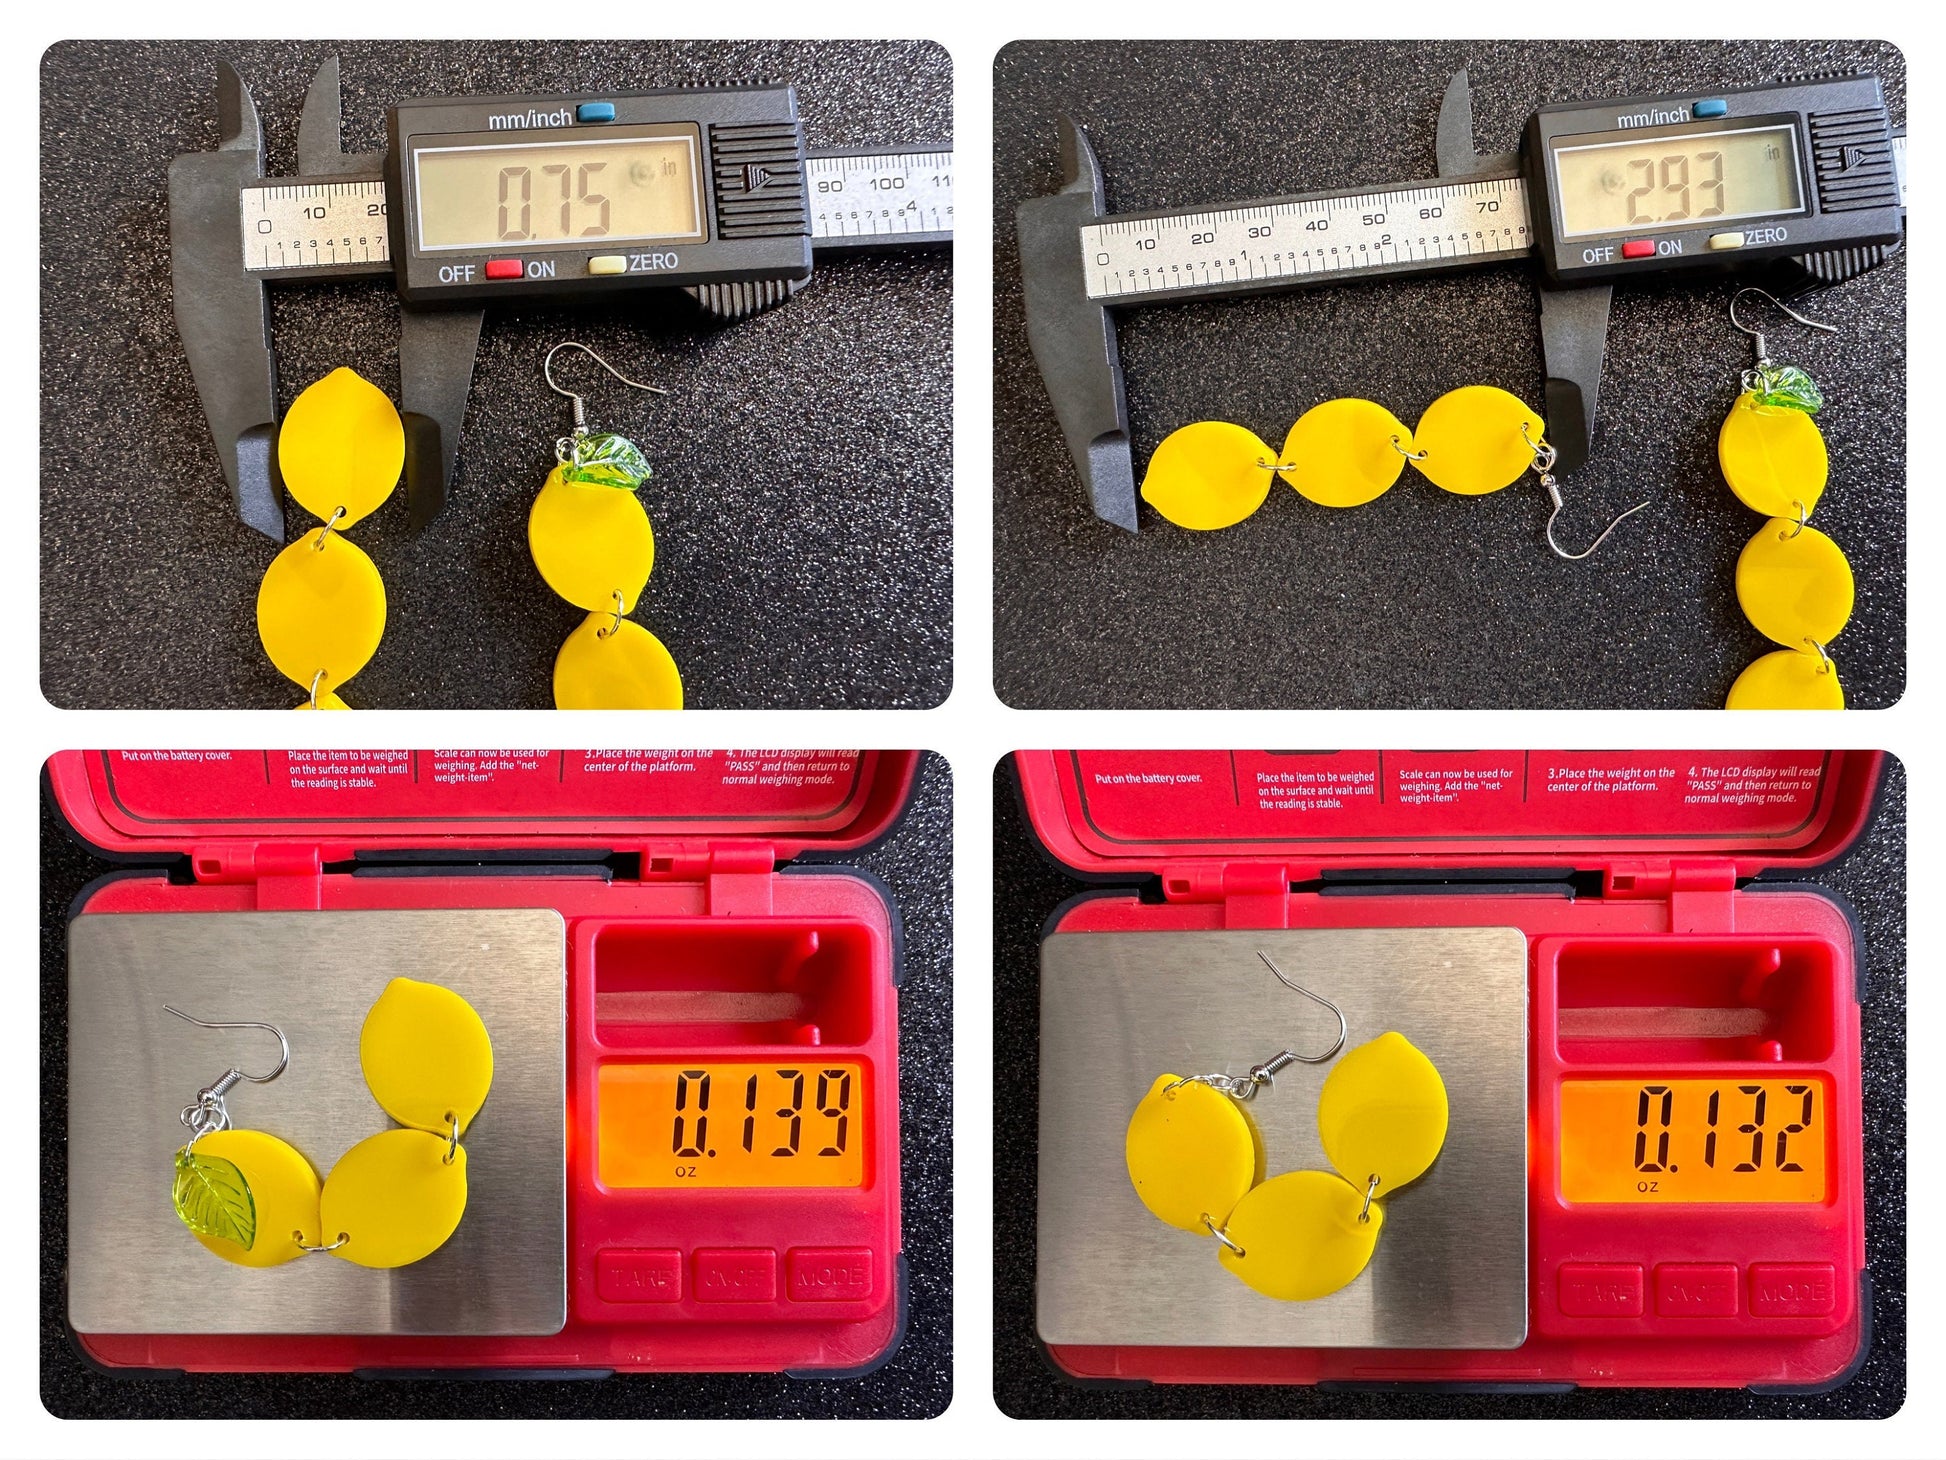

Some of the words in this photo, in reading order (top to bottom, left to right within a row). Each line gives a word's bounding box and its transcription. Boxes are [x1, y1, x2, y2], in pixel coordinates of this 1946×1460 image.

[488, 108, 573, 130] mm/inch
[1617, 106, 1690, 129] mm/inch
[1766, 144, 1780, 161] in
[662, 157, 677, 178] in
[817, 180, 843, 193] 90
[869, 177, 904, 191] 100
[932, 174, 953, 187] 11
[1626, 151, 1725, 225] 2.93
[498, 162, 611, 241] 0.75
[906, 200, 917, 212] 4
[303, 206, 326, 219] 10
[257, 219, 272, 234] 0
[1136, 238, 1156, 251] 10
[1191, 232, 1215, 245] 20
[1248, 226, 1272, 239] 30
[1305, 219, 1329, 232] 40
[1362, 213, 1386, 226] 50
[1419, 207, 1442, 220] 60
[1476, 201, 1499, 214] 70
[1381, 234, 1392, 246] 2
[1745, 227, 1788, 246] ZERO
[1240, 250, 1248, 261] 1
[1582, 247, 1614, 264] OFF
[1658, 240, 1683, 256] ON
[629, 252, 678, 272] ZERO
[1096, 252, 1110, 266] 0
[438, 264, 476, 283] OFF
[527, 260, 556, 279] ON
[121, 750, 139, 761] Put
[140, 752, 152, 760] on
[153, 750, 169, 760] the
[170, 750, 204, 762] battery
[205, 751, 233, 760] cover.
[287, 750, 311, 761] Place
[312, 750, 327, 761] the
[328, 749, 348, 761] item
[349, 750, 358, 760] to
[360, 749, 371, 760] be
[372, 749, 408, 762] weighed
[434, 749, 458, 758] Scale
[459, 750, 476, 758] can
[478, 750, 497, 758] now
[499, 749, 511, 758] be
[512, 749, 534, 758] used
[536, 749, 550, 757] for
[584, 749, 623, 759] 3.Place
[625, 749, 642, 758] the
[644, 749, 679, 760] weight
[681, 750, 694, 758] on
[696, 749, 714, 758] the
[726, 749, 736, 759] 4.
[740, 749, 757, 758] The
[760, 749, 778, 758] LCD
[780, 749, 816, 760] display
[818, 749, 835, 758] will
[837, 749, 860, 758] read
[289, 766, 301, 774] on
[302, 764, 317, 774] the
[318, 763, 349, 774] surface
[350, 763, 366, 774] and
[367, 764, 387, 774] wait
[388, 763, 408, 774] until
[434, 760, 477, 772] weighing.
[479, 760, 497, 770] Add
[499, 760, 515, 770] the
[516, 760, 539, 770] "net-
[584, 762, 616, 772] center
[618, 761, 629, 772] of
[630, 761, 647, 772] the
[649, 761, 696, 774] platform.
[725, 761, 760, 772] "PASS"
[761, 761, 781, 771] and
[782, 761, 805, 771] then
[806, 762, 838, 771] return
[839, 762, 850, 771] to
[1688, 766, 1698, 777] 4.
[1701, 767, 1719, 778] The
[1721, 767, 1740, 777] LCD
[1742, 766, 1777, 779] display
[1779, 766, 1797, 777] will
[1799, 766, 1822, 777] read
[721, 774, 757, 784] normal
[759, 773, 803, 787] weighing
[804, 774, 835, 784] mode.
[1094, 774, 1113, 784] Put
[1113, 775, 1125, 784] on
[1125, 773, 1141, 783] the
[1142, 773, 1175, 785] battery
[1176, 774, 1203, 783] cover.
[1256, 772, 1279, 783] Place
[1280, 772, 1295, 783] the
[1296, 772, 1315, 782] item
[1316, 772, 1326, 782] to
[1327, 771, 1338, 782] be
[1339, 771, 1375, 784] weighed
[1399, 769, 1423, 779] Scale
[1424, 771, 1441, 779] can
[1443, 770, 1462, 779] now
[1464, 769, 1475, 779] be
[1477, 769, 1498, 778] used
[1500, 768, 1514, 778] for
[1547, 767, 1586, 779] 3.Place
[1587, 768, 1605, 778] the
[1607, 767, 1641, 780] weight
[1643, 769, 1656, 778] on
[1658, 767, 1676, 778] the
[290, 777, 305, 788] the
[307, 777, 339, 790] reading
[340, 777, 347, 788] is
[348, 777, 377, 788] stable.
[1258, 787, 1269, 796] on
[1270, 785, 1285, 796] the
[1286, 785, 1316, 796] surface
[1317, 785, 1333, 795] and
[1335, 785, 1353, 795] wait
[1354, 784, 1374, 795] until
[1399, 781, 1442, 793] weighing.
[1444, 781, 1462, 790] Add
[1464, 781, 1479, 790] the
[1480, 781, 1503, 790] "net-
[1547, 782, 1579, 792] center
[1581, 781, 1592, 792] of
[1593, 781, 1610, 792] the
[1612, 780, 1659, 794] platform.
[1687, 780, 1722, 791] "PASS"
[1723, 780, 1743, 790] and
[1744, 780, 1767, 790] then
[1768, 781, 1799, 790] return
[1801, 781, 1812, 790] to
[1260, 799, 1274, 809] the
[1275, 798, 1306, 811] reading
[1307, 798, 1315, 808] is
[1316, 798, 1344, 808] stable.
[1684, 793, 1720, 804] normal
[1721, 792, 1765, 806] weighing
[1766, 792, 1797, 803] mode.
[672, 1069, 850, 1158] 0.139
[1634, 1085, 1813, 1173] 0.132
[798, 1268, 864, 1286] MODE
[1760, 1283, 1827, 1302] MODE
